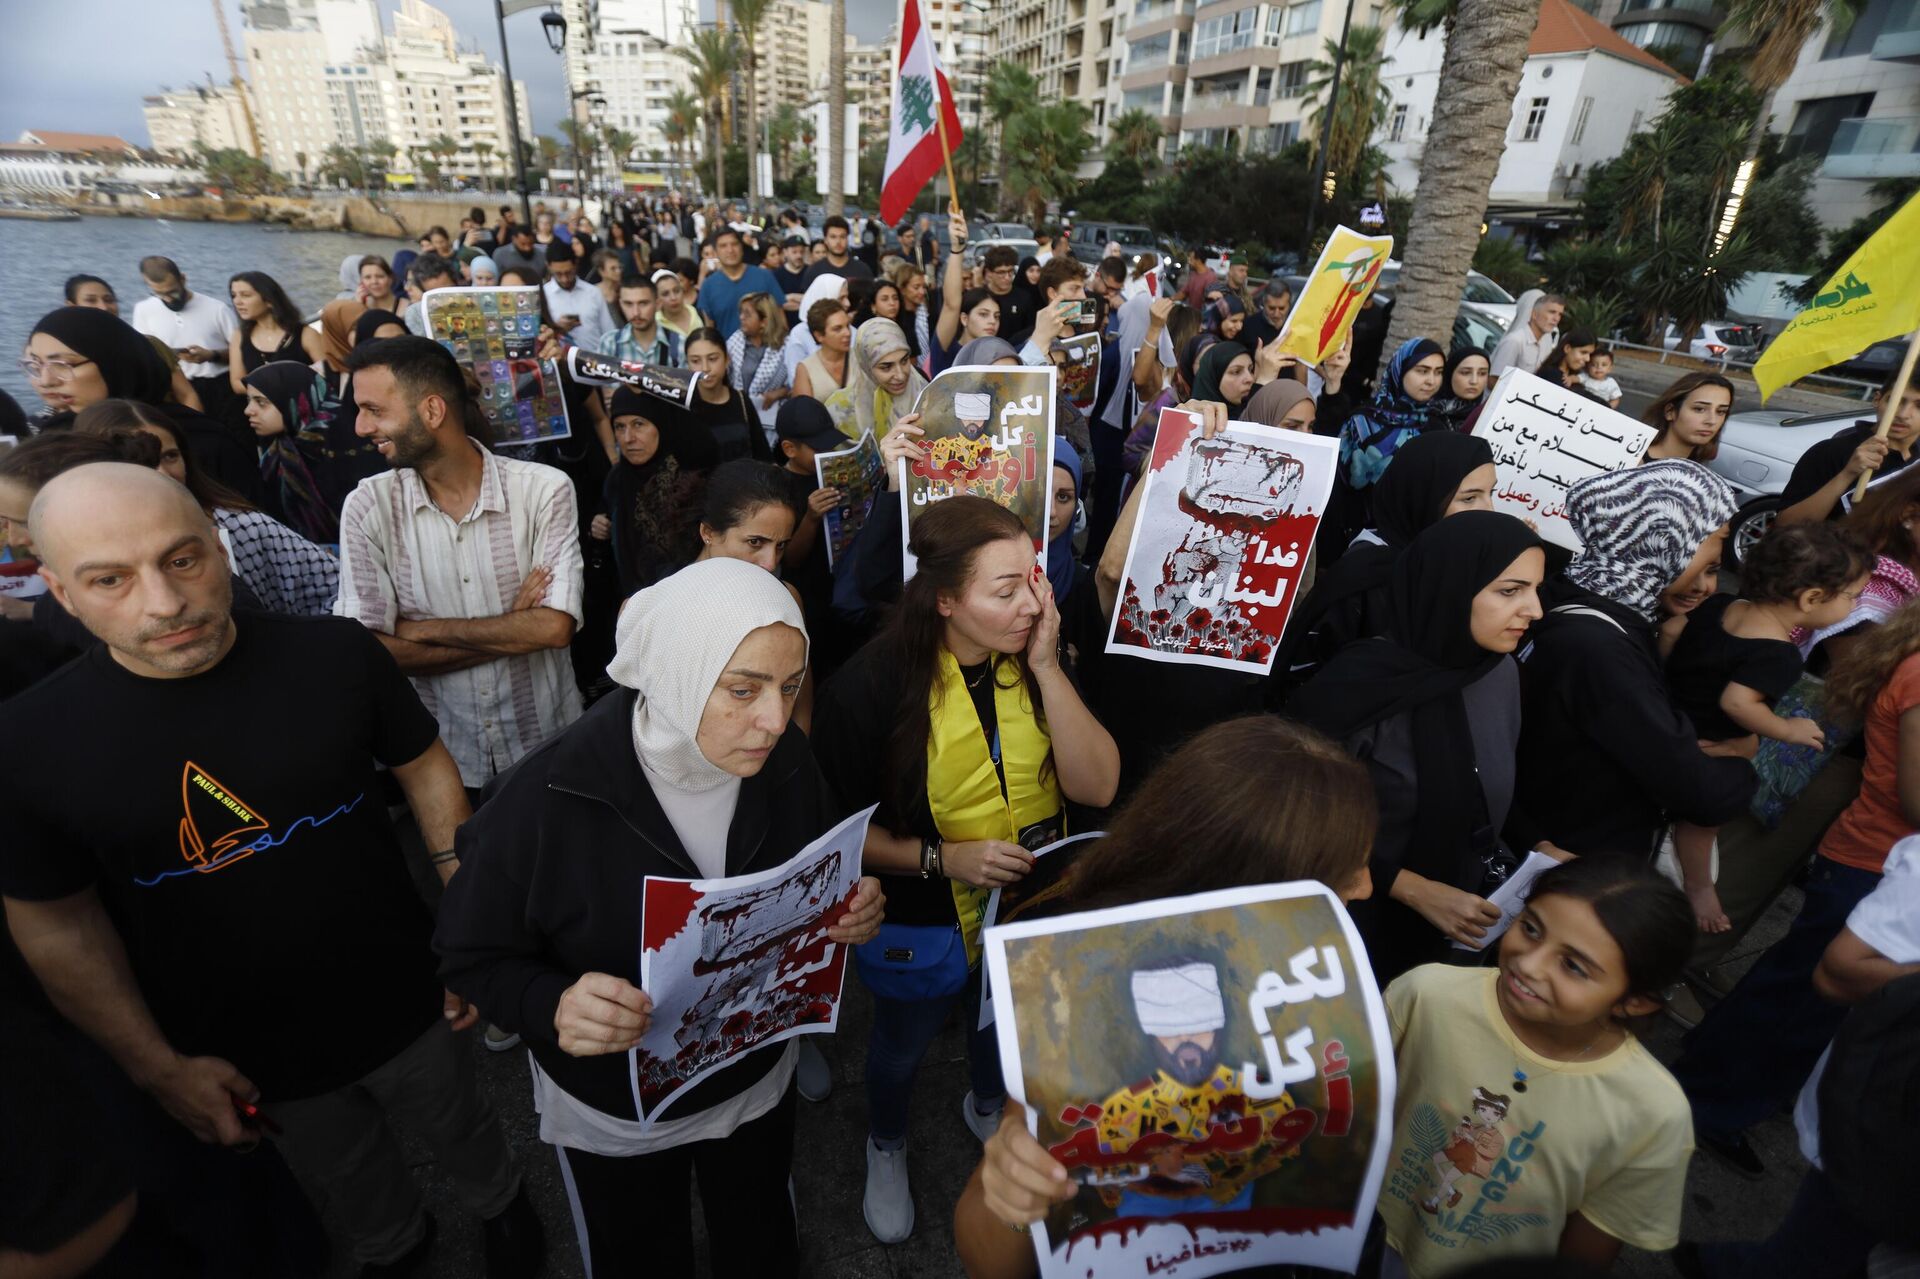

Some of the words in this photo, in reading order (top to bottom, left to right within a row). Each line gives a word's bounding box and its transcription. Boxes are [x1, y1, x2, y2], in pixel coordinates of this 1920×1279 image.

[1841, 302, 1877, 316] المقاومة
[581, 359, 638, 384] عيونكن
[642, 376, 681, 399] عيونا
[999, 394, 1043, 425] لكم
[1492, 415, 1514, 433] من
[990, 423, 1025, 451] كل
[1515, 427, 1538, 446] مع
[1579, 419, 1624, 444] من
[910, 431, 1037, 496] أوسمة
[912, 485, 955, 506] لبنان
[1497, 481, 1540, 511] وعميل
[1541, 501, 1570, 521] ائن
[1189, 571, 1289, 616] لبنان
[192, 774, 215, 796] PAUL
[214, 791, 224, 800] &
[221, 796, 254, 823] SHARK
[718, 942, 837, 1018] لبنان
[1248, 944, 1346, 1034] لكم
[1241, 1025, 1317, 1100] كل
[1048, 1038, 1355, 1172] أوسمة
[1403, 1147, 1428, 1163] GET
[1077, 1163, 1150, 1186] لبنا
[1391, 1175, 1416, 1196] BIG
[1400, 1155, 1437, 1189] READY
[1456, 1120, 1547, 1234] JUNGLE
[1145, 1239, 1251, 1276] #تعافينا
